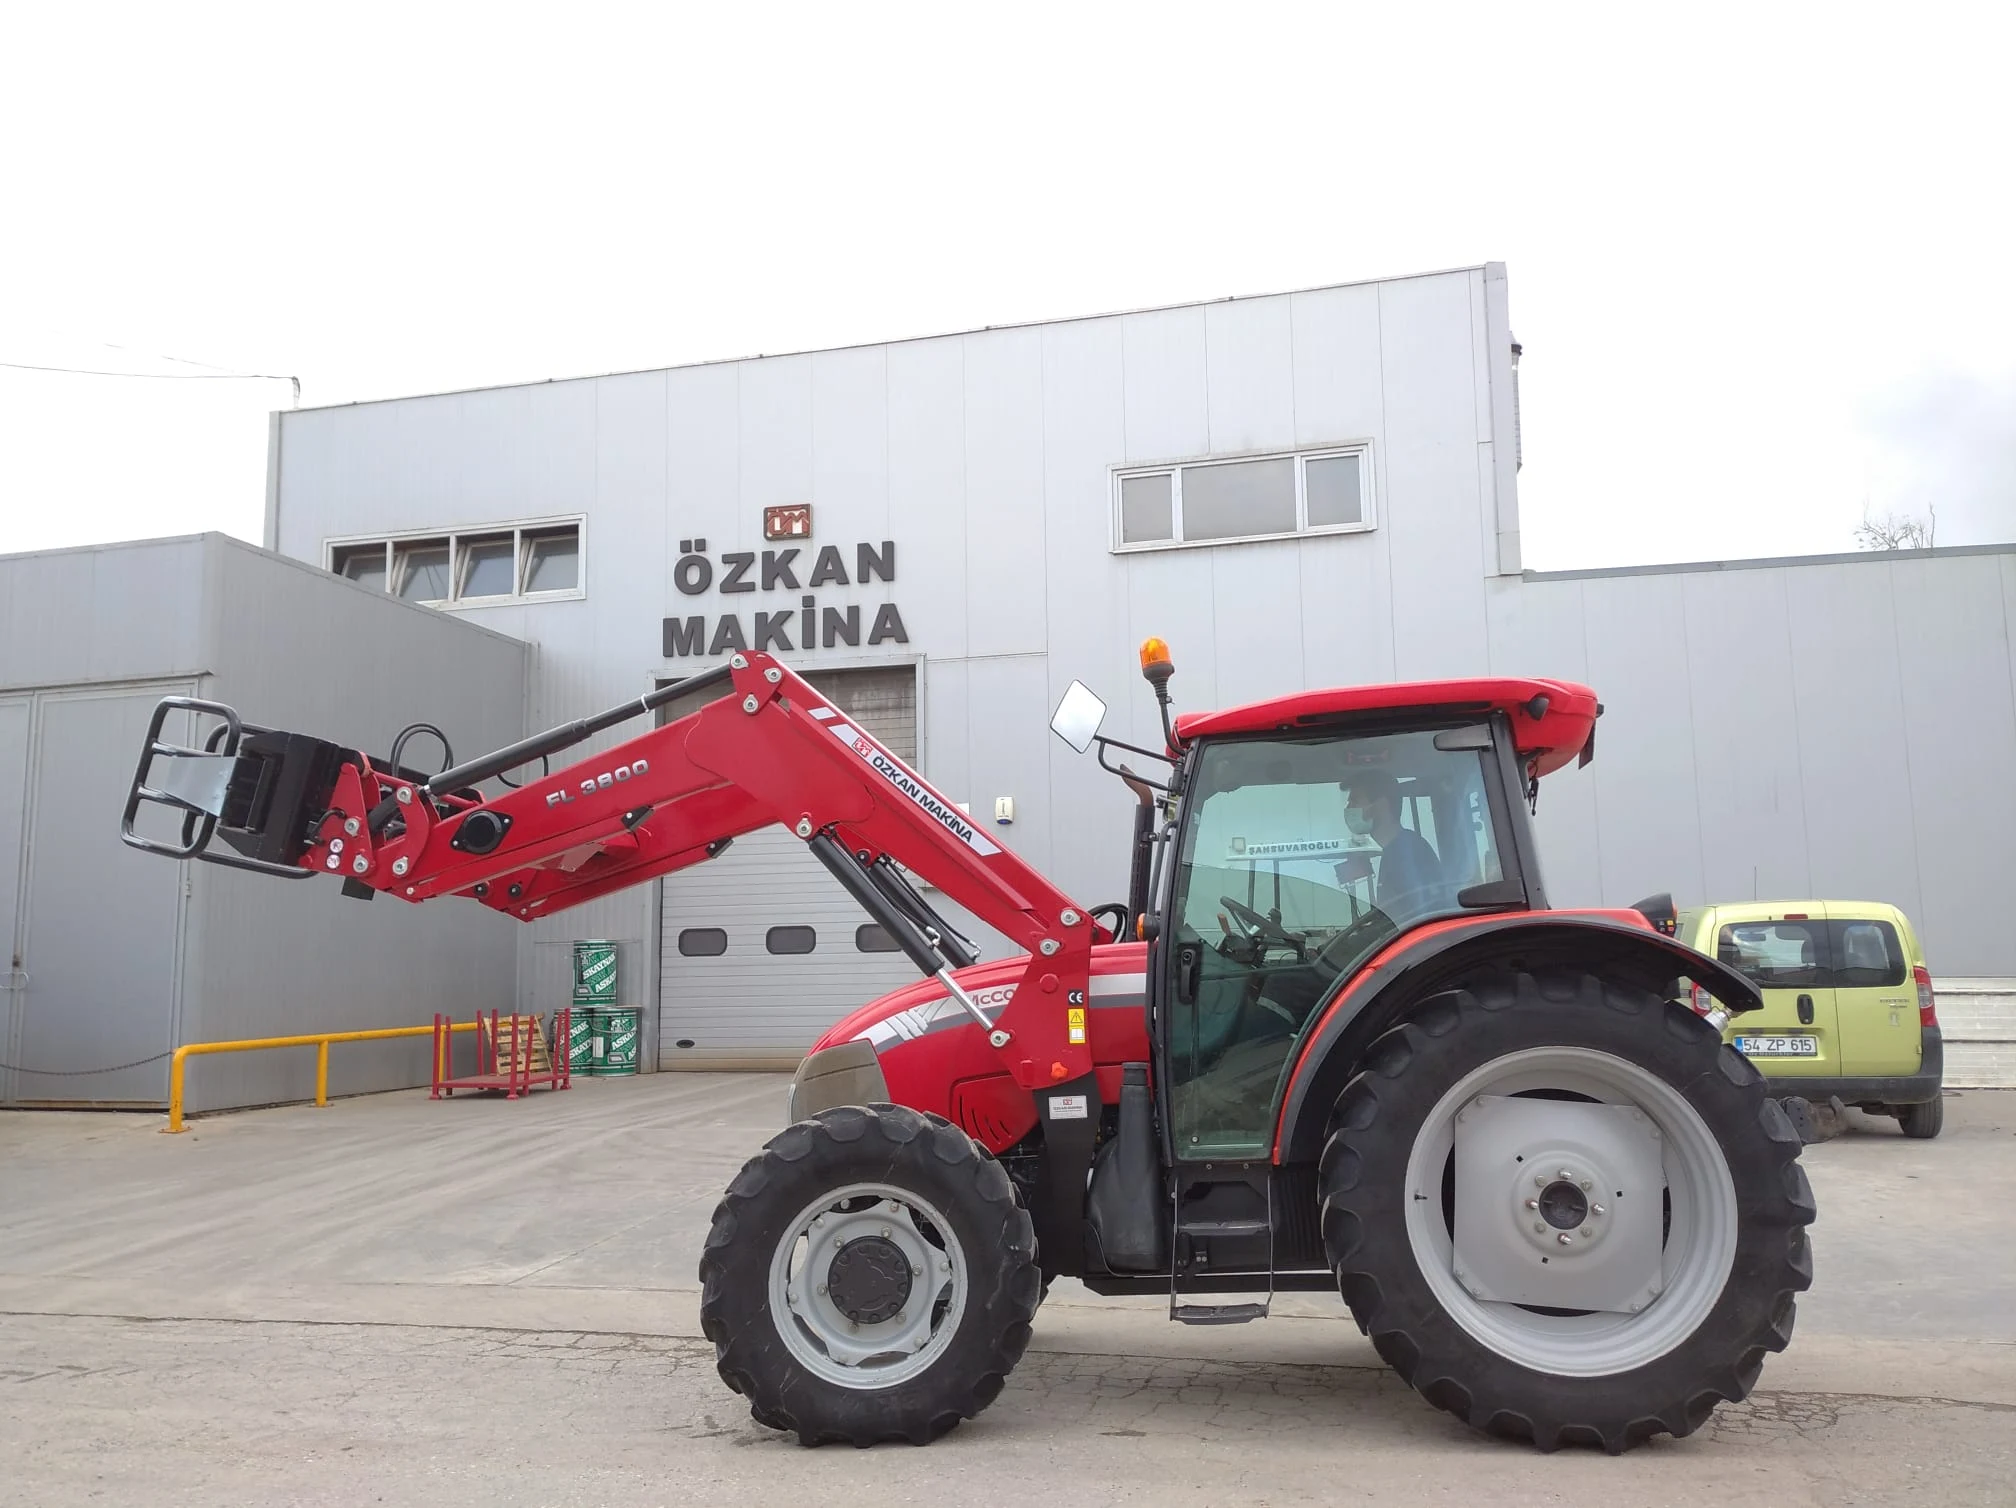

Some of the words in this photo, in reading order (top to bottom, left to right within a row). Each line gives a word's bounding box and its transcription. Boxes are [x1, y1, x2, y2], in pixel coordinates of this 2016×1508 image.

[674, 538, 895, 595] ÖZKAN
[662, 595, 909, 657] MAKİNA
[546, 789, 575, 809] FL
[580, 759, 649, 796] 3800
[872, 755, 920, 798] ÖZKAN
[919, 794, 973, 843] MAKİNA
[1743, 1039, 1760, 1051] 54
[1766, 1039, 1786, 1051] ZP
[1791, 1039, 1812, 1051] 615
